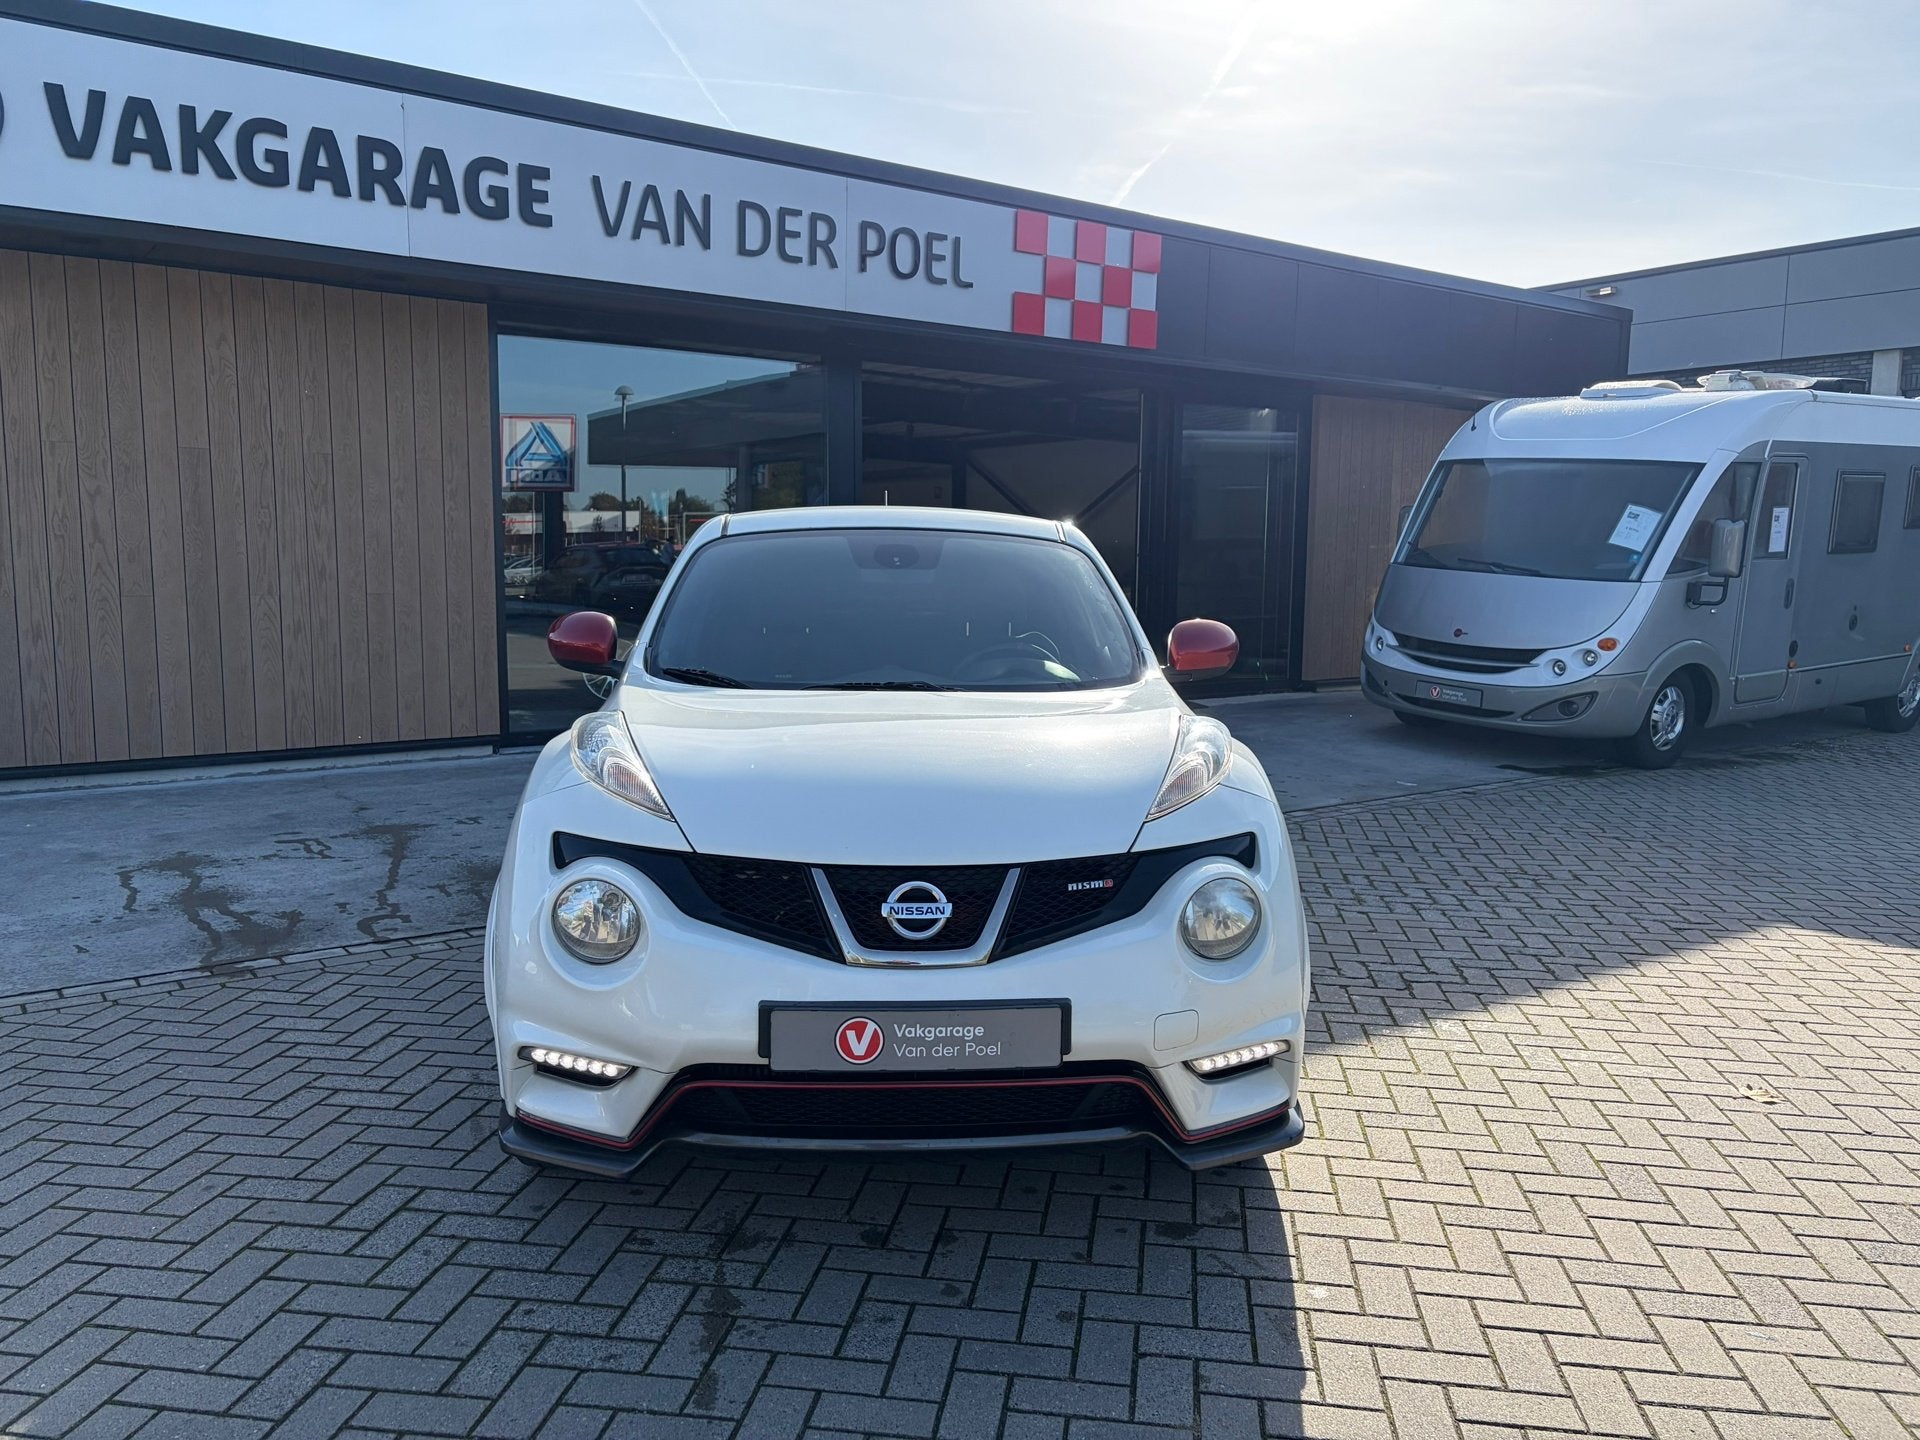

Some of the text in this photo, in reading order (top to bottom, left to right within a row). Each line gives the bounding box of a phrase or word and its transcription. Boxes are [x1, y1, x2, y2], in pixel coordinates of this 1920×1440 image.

[43, 82, 975, 290] VAKGARAGE VAN DER POEL
[889, 906, 946, 916] NISSAN
[893, 1023, 985, 1040] Vakgarage
[893, 1041, 1001, 1057] Van der Poel
